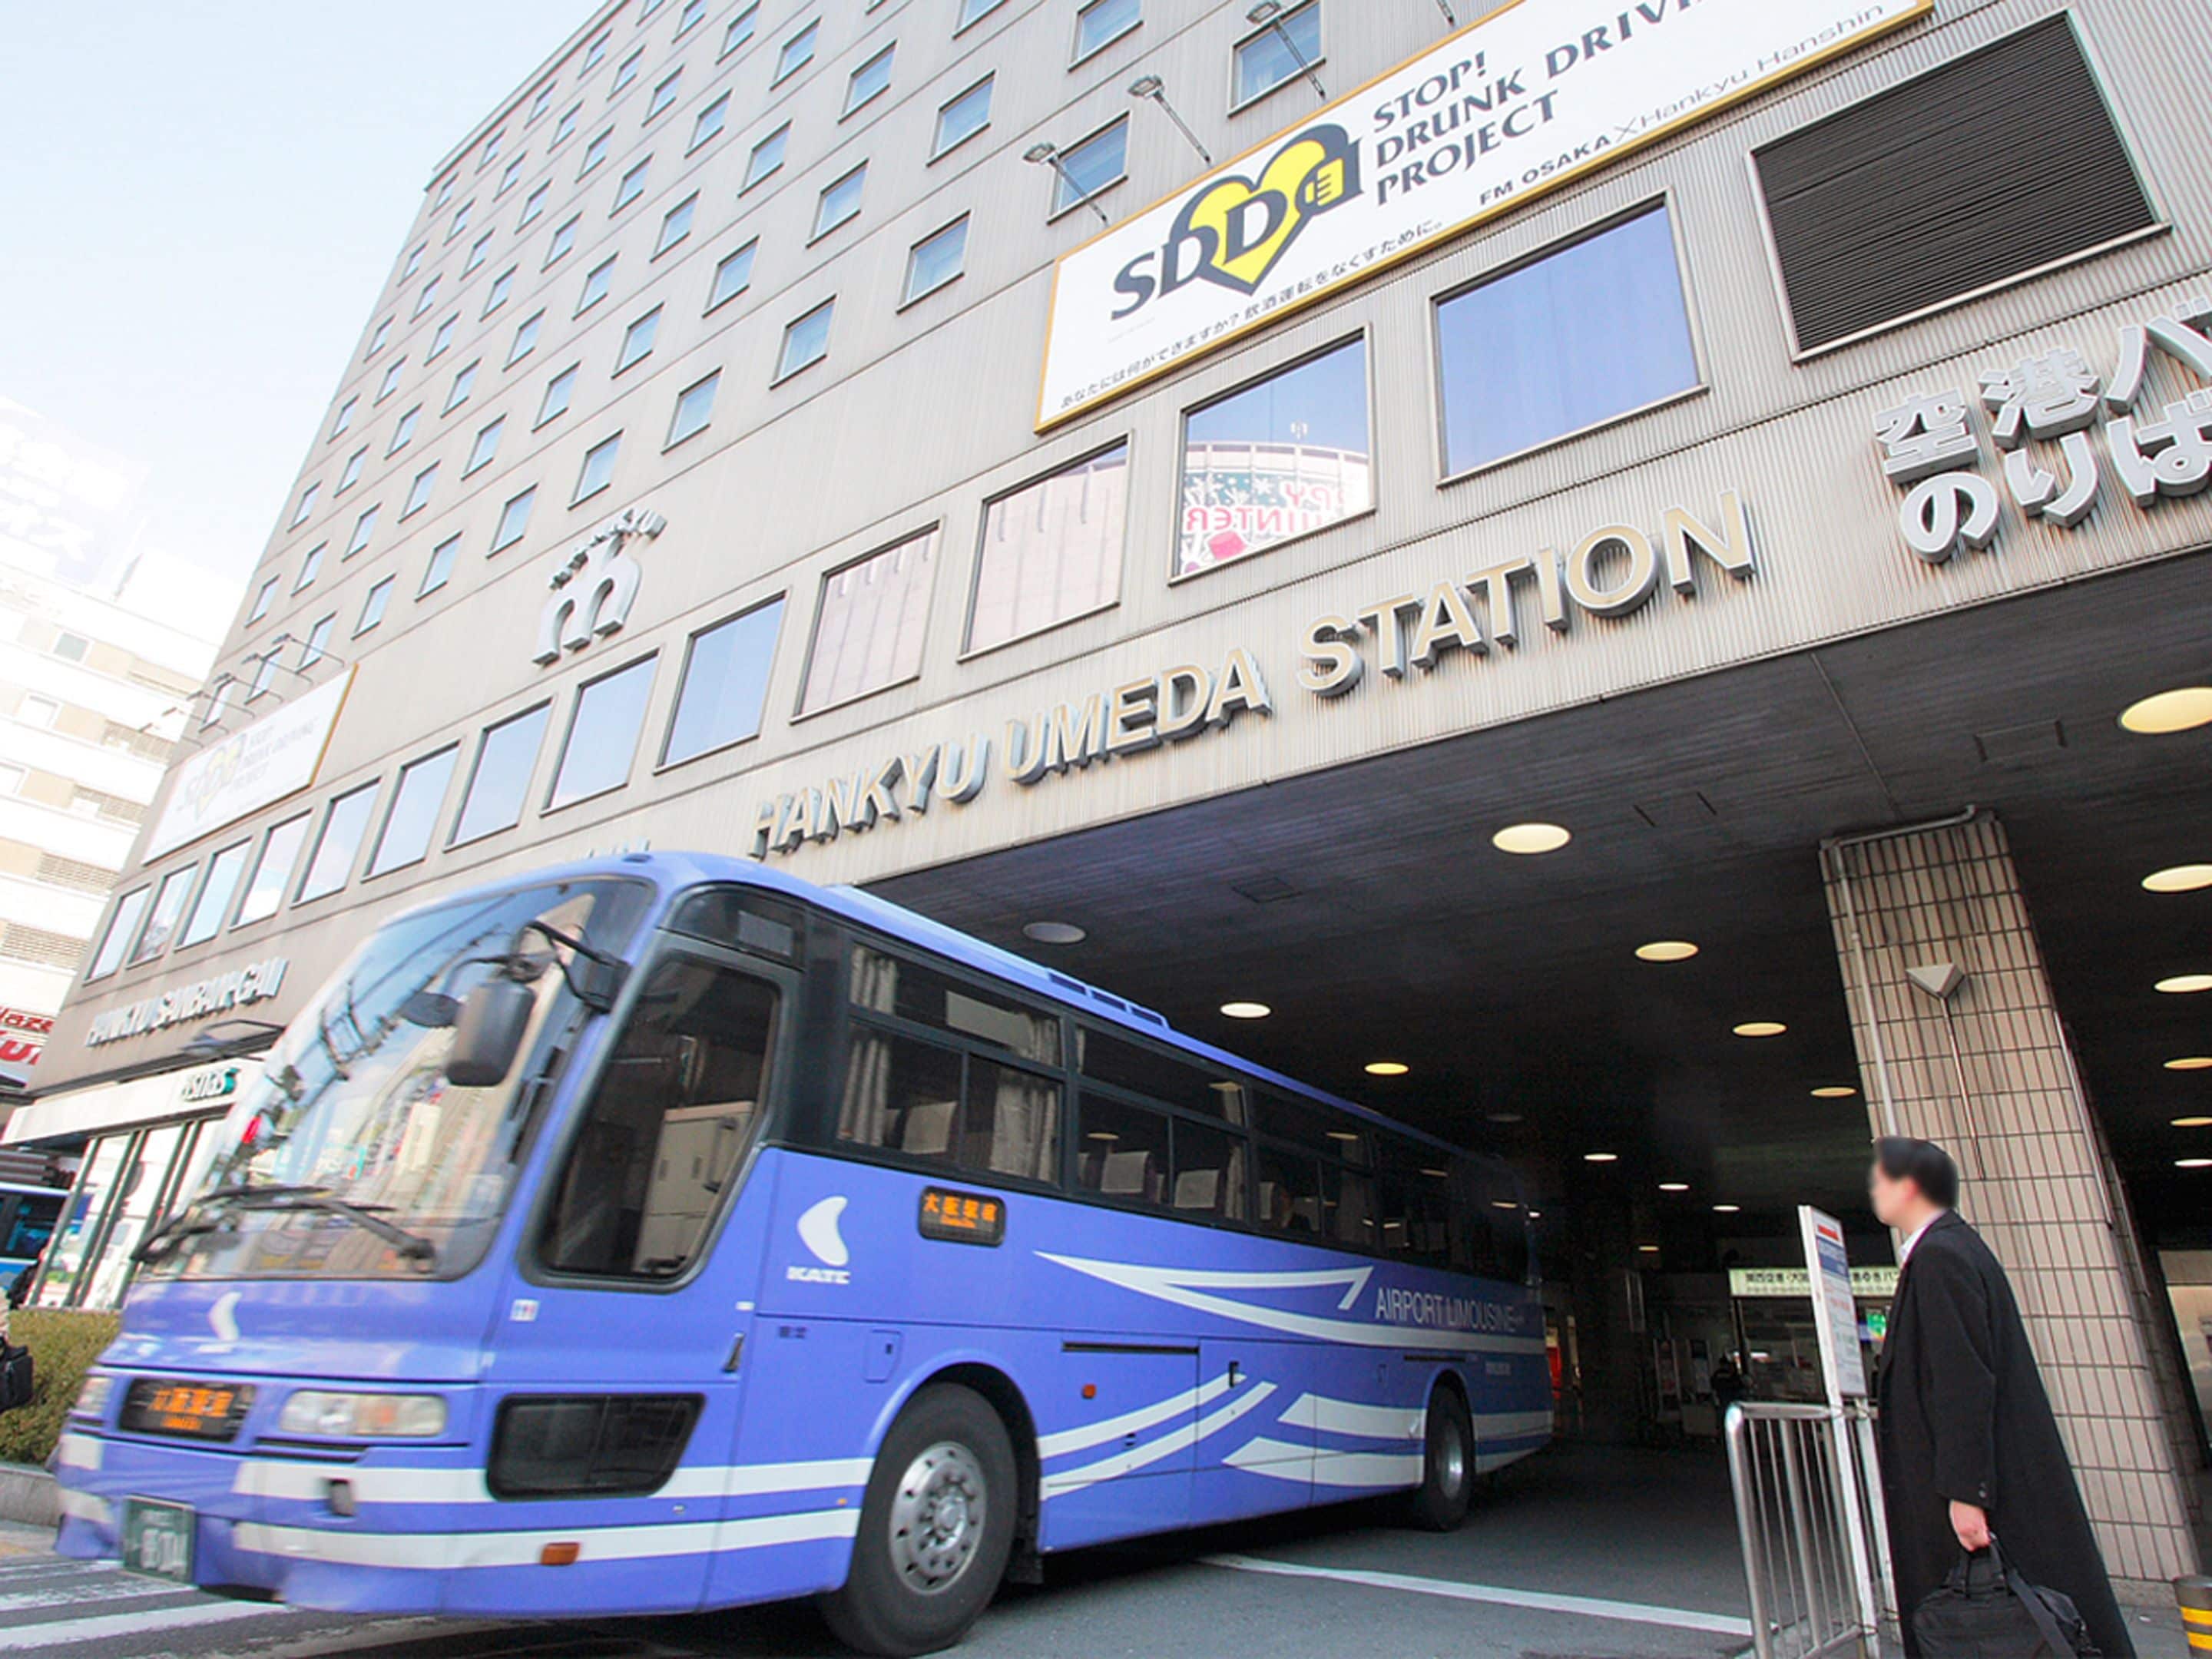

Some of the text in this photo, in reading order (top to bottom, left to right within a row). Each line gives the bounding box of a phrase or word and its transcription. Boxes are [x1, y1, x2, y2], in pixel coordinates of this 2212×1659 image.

[1373, 50, 1487, 134] STOP!
[1376, 0, 1700, 169] DRUNK DRIV
[1376, 88, 1559, 207] PROJECT
[1479, 179, 1514, 206] FM
[1522, 134, 1611, 184] OSAKA
[1758, 4, 1884, 72] Hanshin
[1899, 386, 2212, 565] のりば
[748, 488, 1757, 860] HANKYU UMEDA STATION
[1375, 1286, 1443, 1326] AIRPORT
